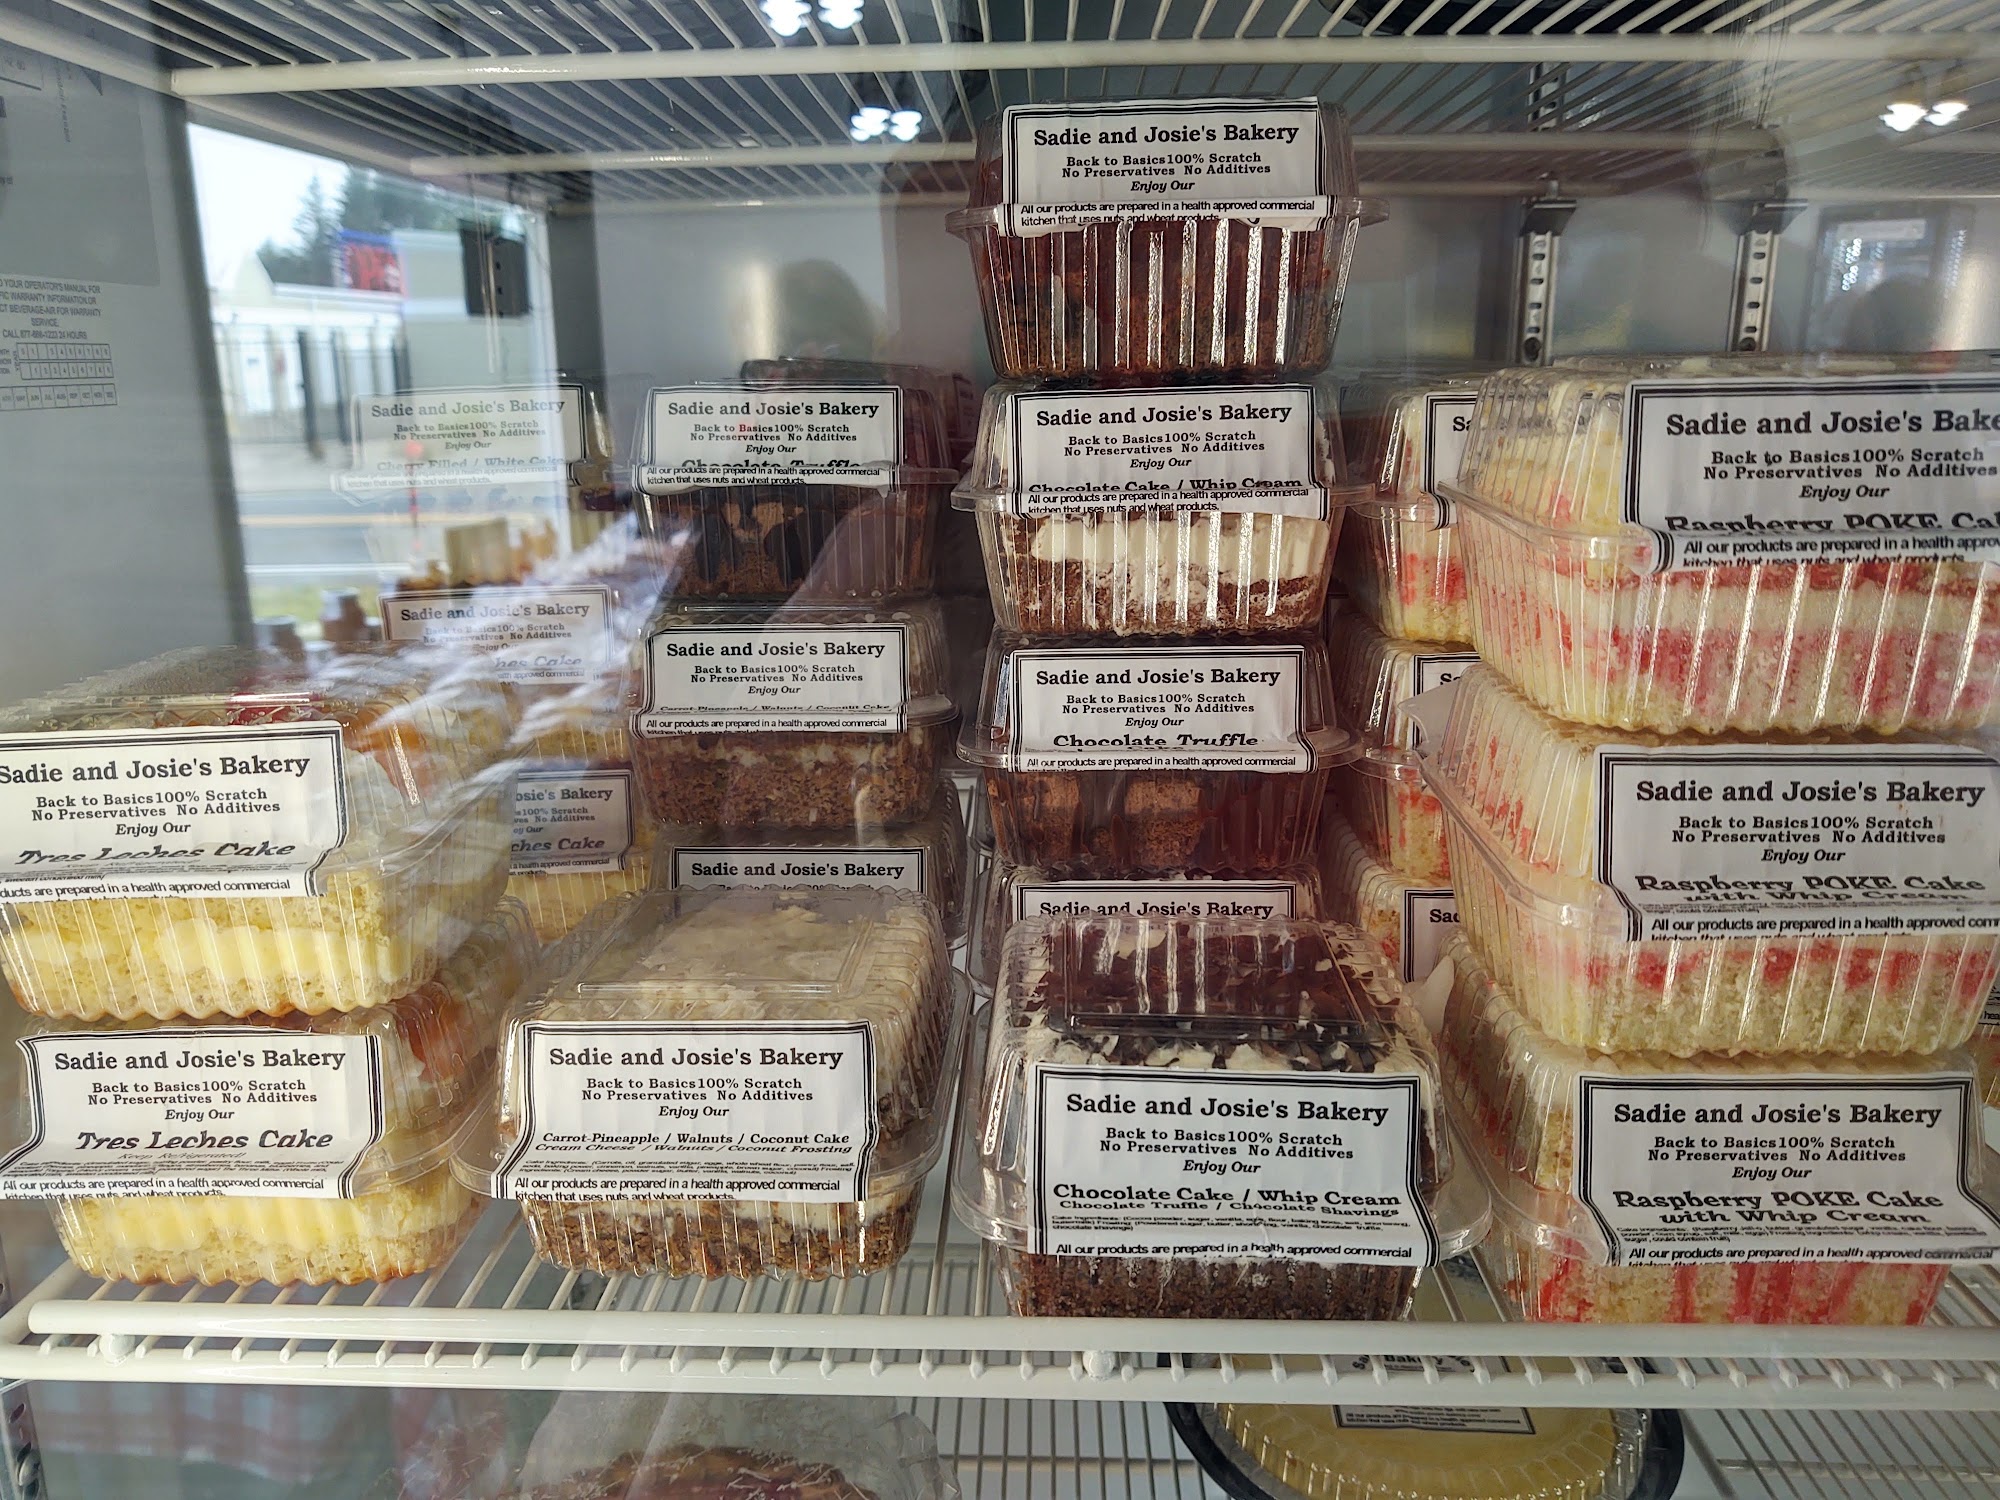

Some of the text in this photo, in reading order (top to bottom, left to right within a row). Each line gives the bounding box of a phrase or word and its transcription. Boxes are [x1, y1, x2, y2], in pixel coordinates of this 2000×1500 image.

[1034, 124, 1299, 145] Sadie and Josie's Bakery
[372, 400, 565, 417] Sadie and Josie's Bakery
[669, 402, 879, 418] Sadie and Josie's Bakery
[1037, 404, 1292, 426] Sadie and Josie's Bakery
[1667, 412, 1746, 435] Sadie
[1757, 411, 1811, 434] and
[1822, 410, 1922, 433] Josie's
[401, 608, 441, 621] Sadie
[447, 606, 477, 619] and
[537, 604, 589, 617] Bakery
[667, 642, 885, 658] Sadie and Josie's Bakery
[1037, 668, 1280, 686] Sadie and Josie's Bakery
[1054, 734, 1258, 746] Chocolate Truffle
[0, 755, 310, 784] Sadie and Josie's Bakery
[516, 788, 613, 801] osie's Bakery
[1637, 780, 1985, 807] Sadie and Josie's Bakery
[558, 837, 604, 850] Cake
[15, 841, 295, 864] Tres Leches Cake
[692, 862, 904, 879] Sadie and Josie's Bakery
[1635, 875, 1985, 893] Raspberry POKE Cake
[1686, 891, 1759, 901] with
[1040, 902, 1273, 920] Sadie and Josie's Bakery
[55, 1049, 346, 1070] Sadie and Josie's Bakery
[550, 1048, 843, 1069] Sadie and Josie's Bakery
[588, 1078, 623, 1088] Back
[629, 1079, 643, 1088] to
[745, 1078, 802, 1088] Scratch
[582, 1090, 812, 1100] No Preservatives No Additives
[165, 1109, 234, 1122] Enjoy Our
[659, 1106, 729, 1119] Enjoy Our
[1067, 1094, 1388, 1126] Sadie and Josie's Bakery
[1615, 1104, 1942, 1128] Sadie and Josie's Bakery
[76, 1129, 333, 1149] Tres Leches Cake
[543, 1133, 659, 1144] Carrot-Pineapple
[678, 1134, 732, 1143] Walnuts
[751, 1134, 808, 1143] Coconut
[814, 1134, 849, 1143] Cake
[1732, 1167, 1812, 1181] Enjoy Our
[515, 1178, 528, 1188] All
[532, 1180, 549, 1188] our
[552, 1178, 597, 1190] products
[620, 1178, 666, 1191] prepared
[691, 1179, 723, 1188] health
[726, 1180, 775, 1192] approved
[778, 1180, 839, 1190] commercial
[1054, 1184, 1170, 1200] Chocolate
[1177, 1188, 1233, 1200] Cake
[1258, 1190, 1318, 1204] Whip
[1325, 1192, 1401, 1205] Cream
[1613, 1191, 1943, 1210] Raspberry POKE Cake
[1060, 1201, 1144, 1209] Chocolate
[1230, 1203, 1315, 1211] Chocolate
[1321, 1207, 1398, 1217] Shavings
[1660, 1210, 1930, 1224] with Whip Cream
